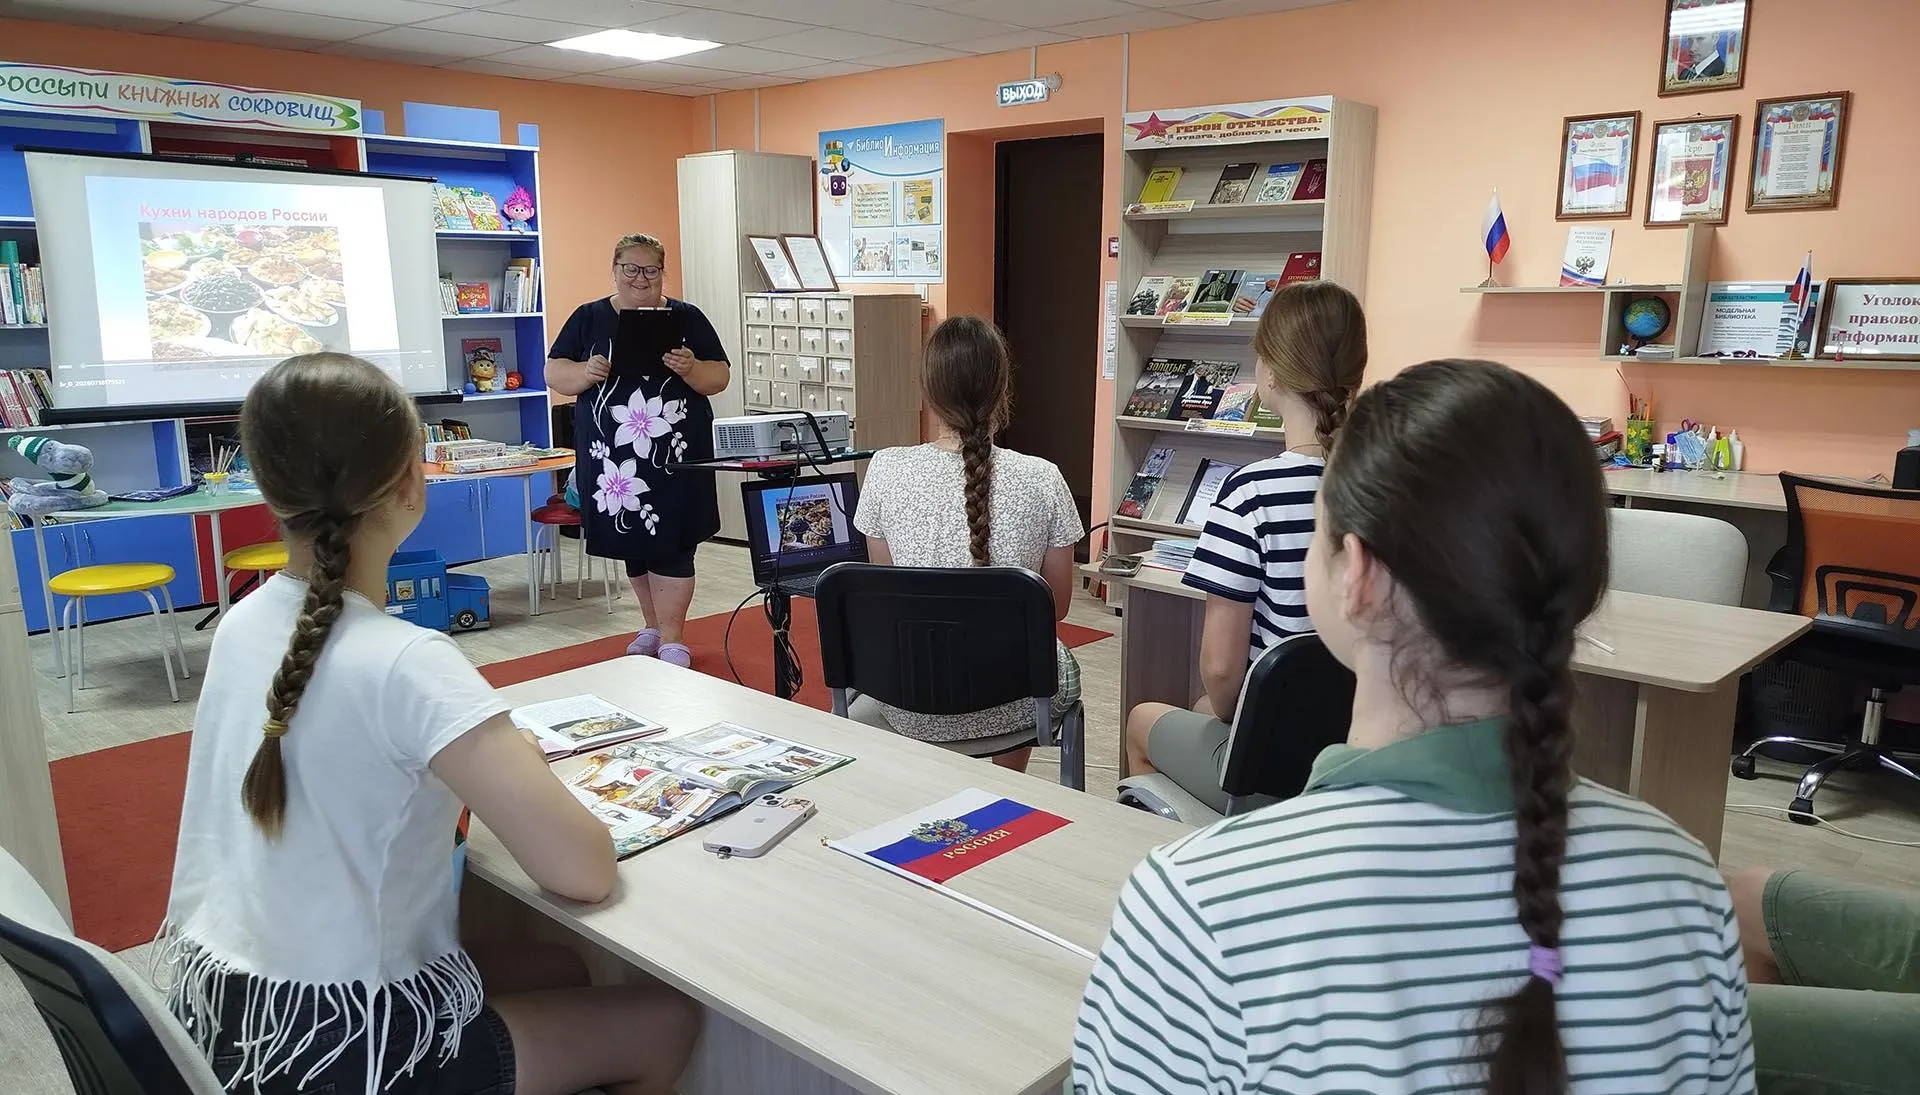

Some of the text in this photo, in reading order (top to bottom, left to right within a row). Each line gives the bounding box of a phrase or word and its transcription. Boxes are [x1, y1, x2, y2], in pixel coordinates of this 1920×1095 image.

[1002, 83, 1045, 102] ВЫХОД
[118, 84, 220, 108] КНИЖНЫХ
[228, 95, 337, 126] СОКРОВИЩ
[1226, 116, 1322, 130] ОТЕЧЕСТВА:
[1176, 133, 1216, 141] отвага,
[1285, 125, 1321, 133] честь
[140, 203, 328, 222] Кухни народов России
[1863, 294, 1920, 306] Уголок
[1849, 315, 1920, 327] правово
[1831, 330, 1920, 345] иформац
[1147, 362, 1187, 373] ЗОЛОТЫЕ
[943, 829, 1012, 859] РОССИЯ
